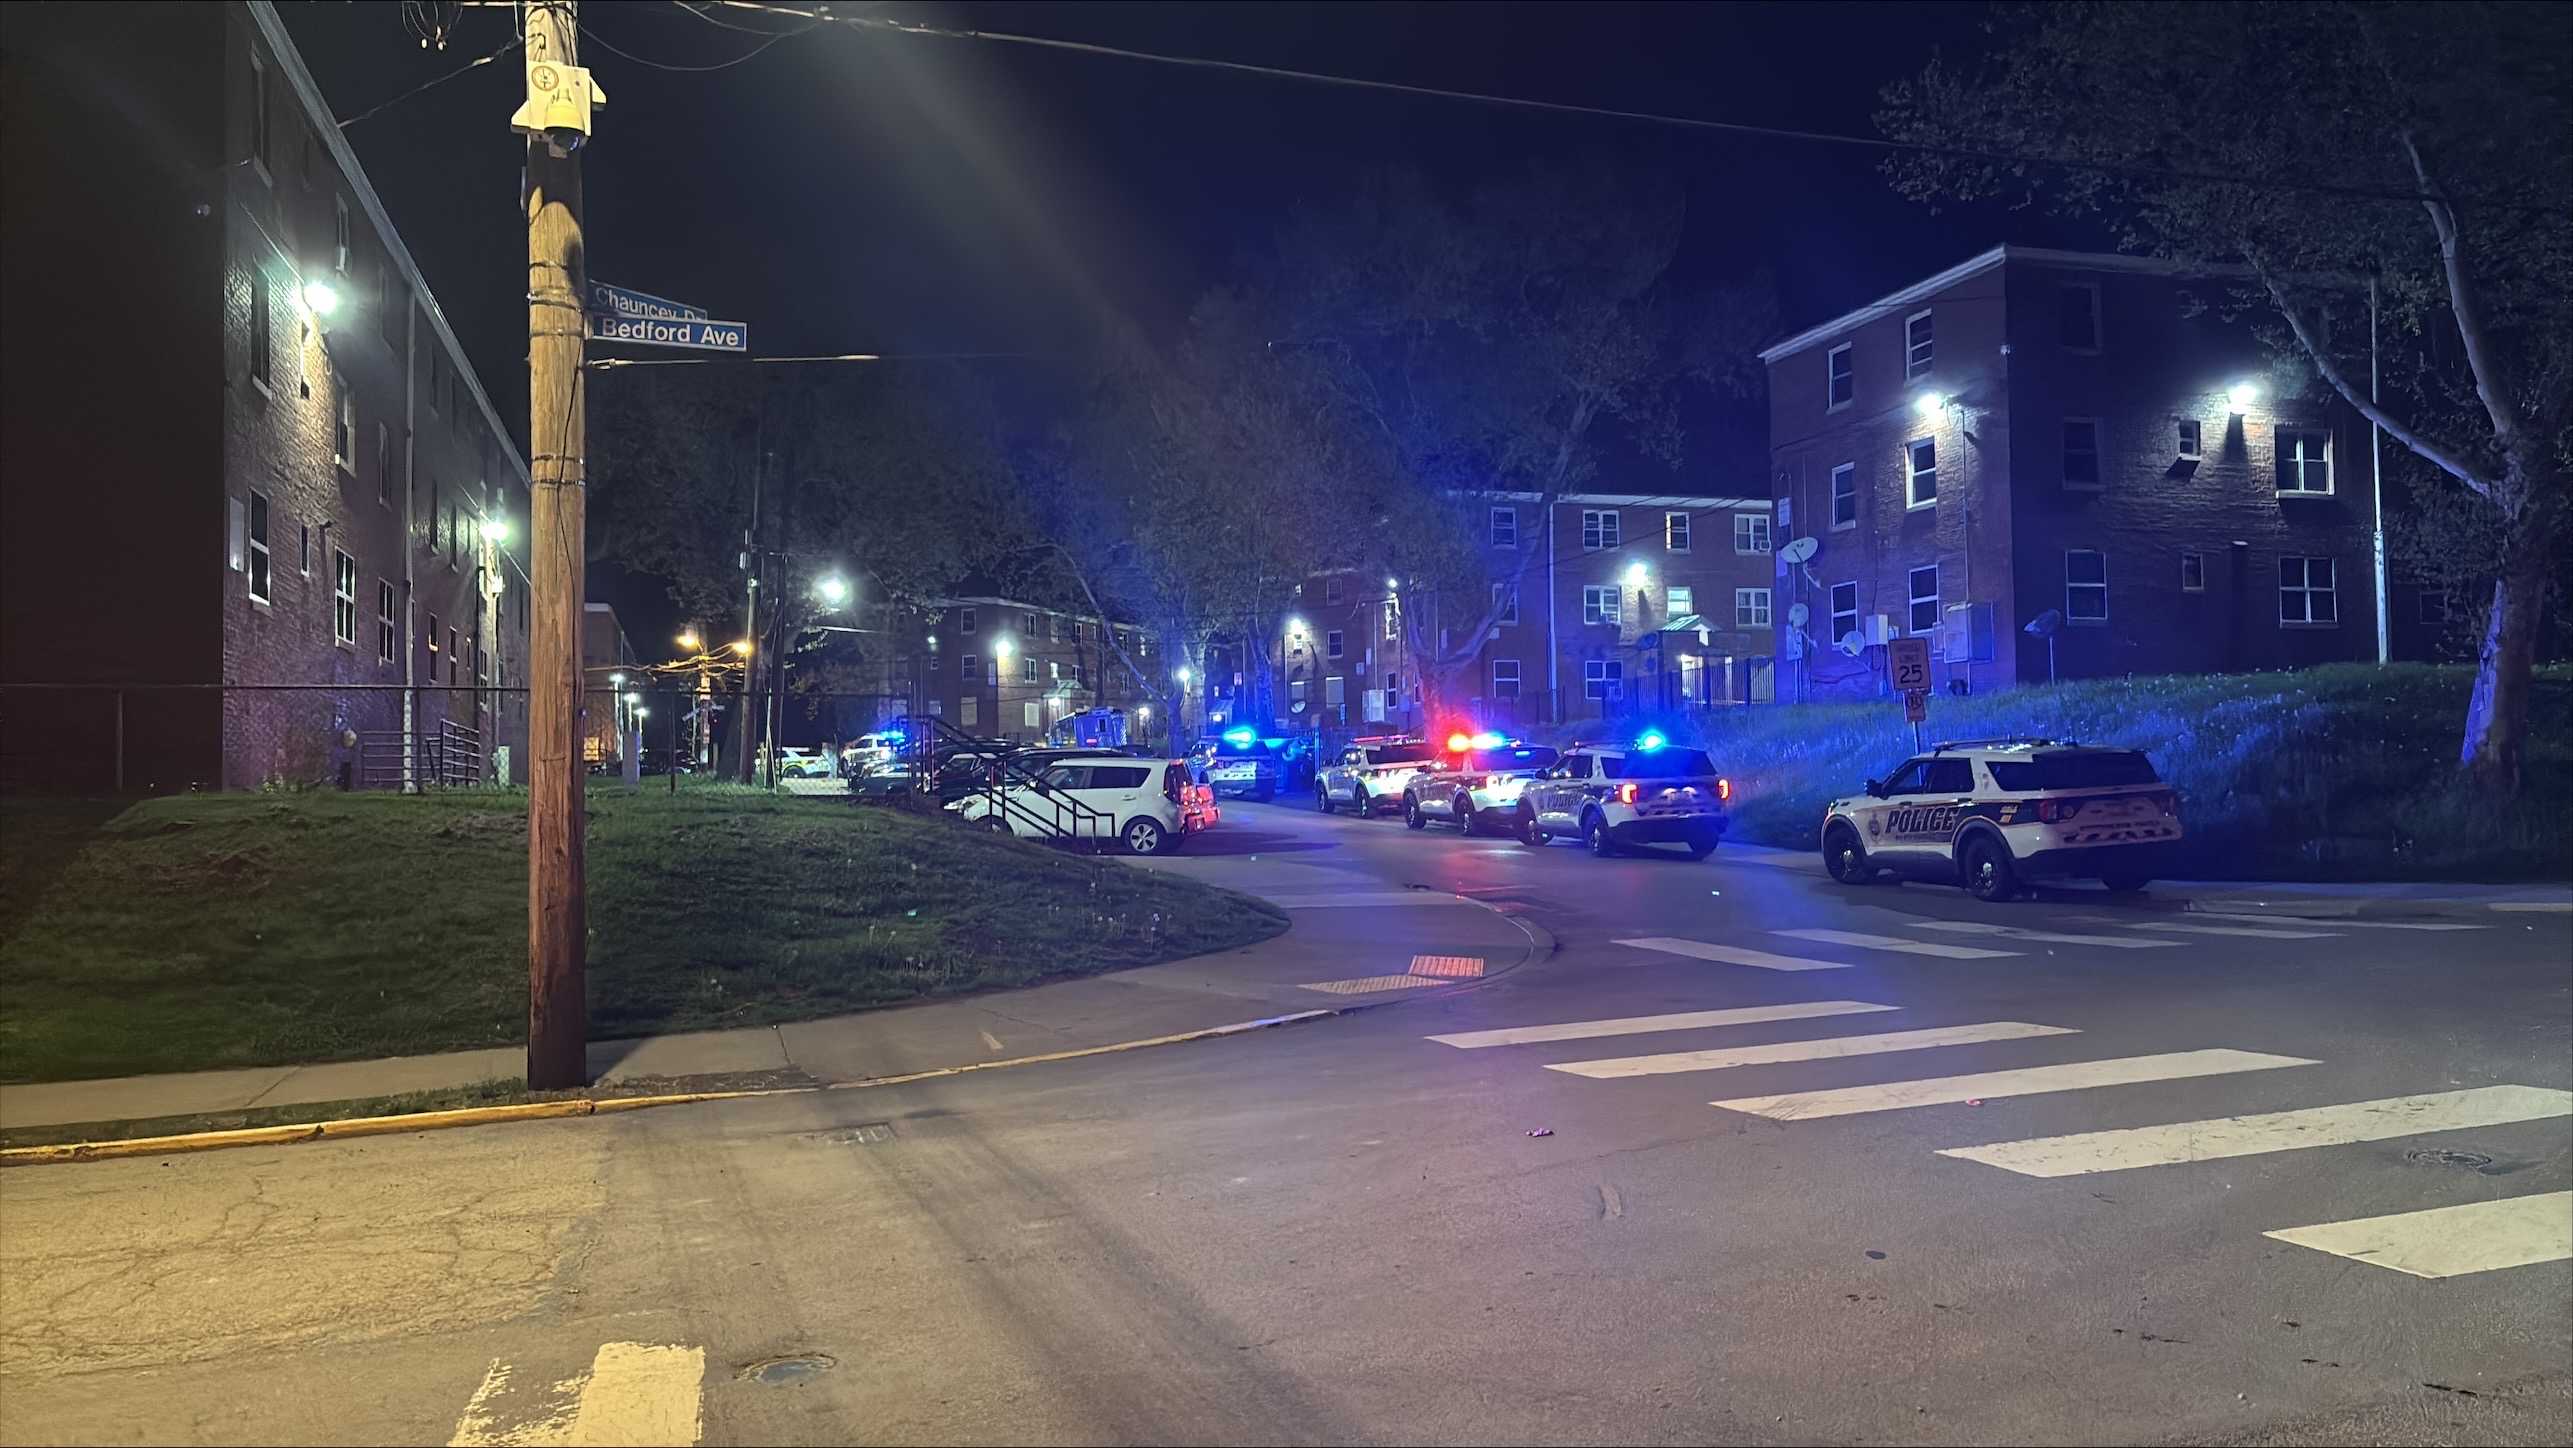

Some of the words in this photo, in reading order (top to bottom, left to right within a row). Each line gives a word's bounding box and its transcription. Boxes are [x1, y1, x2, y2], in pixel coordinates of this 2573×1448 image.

[595, 287, 677, 319] Chauncey
[602, 317, 691, 343] Bedford
[700, 325, 739, 346] Ave
[1899, 664, 1922, 684] 25
[1885, 807, 1960, 834] POLICE
